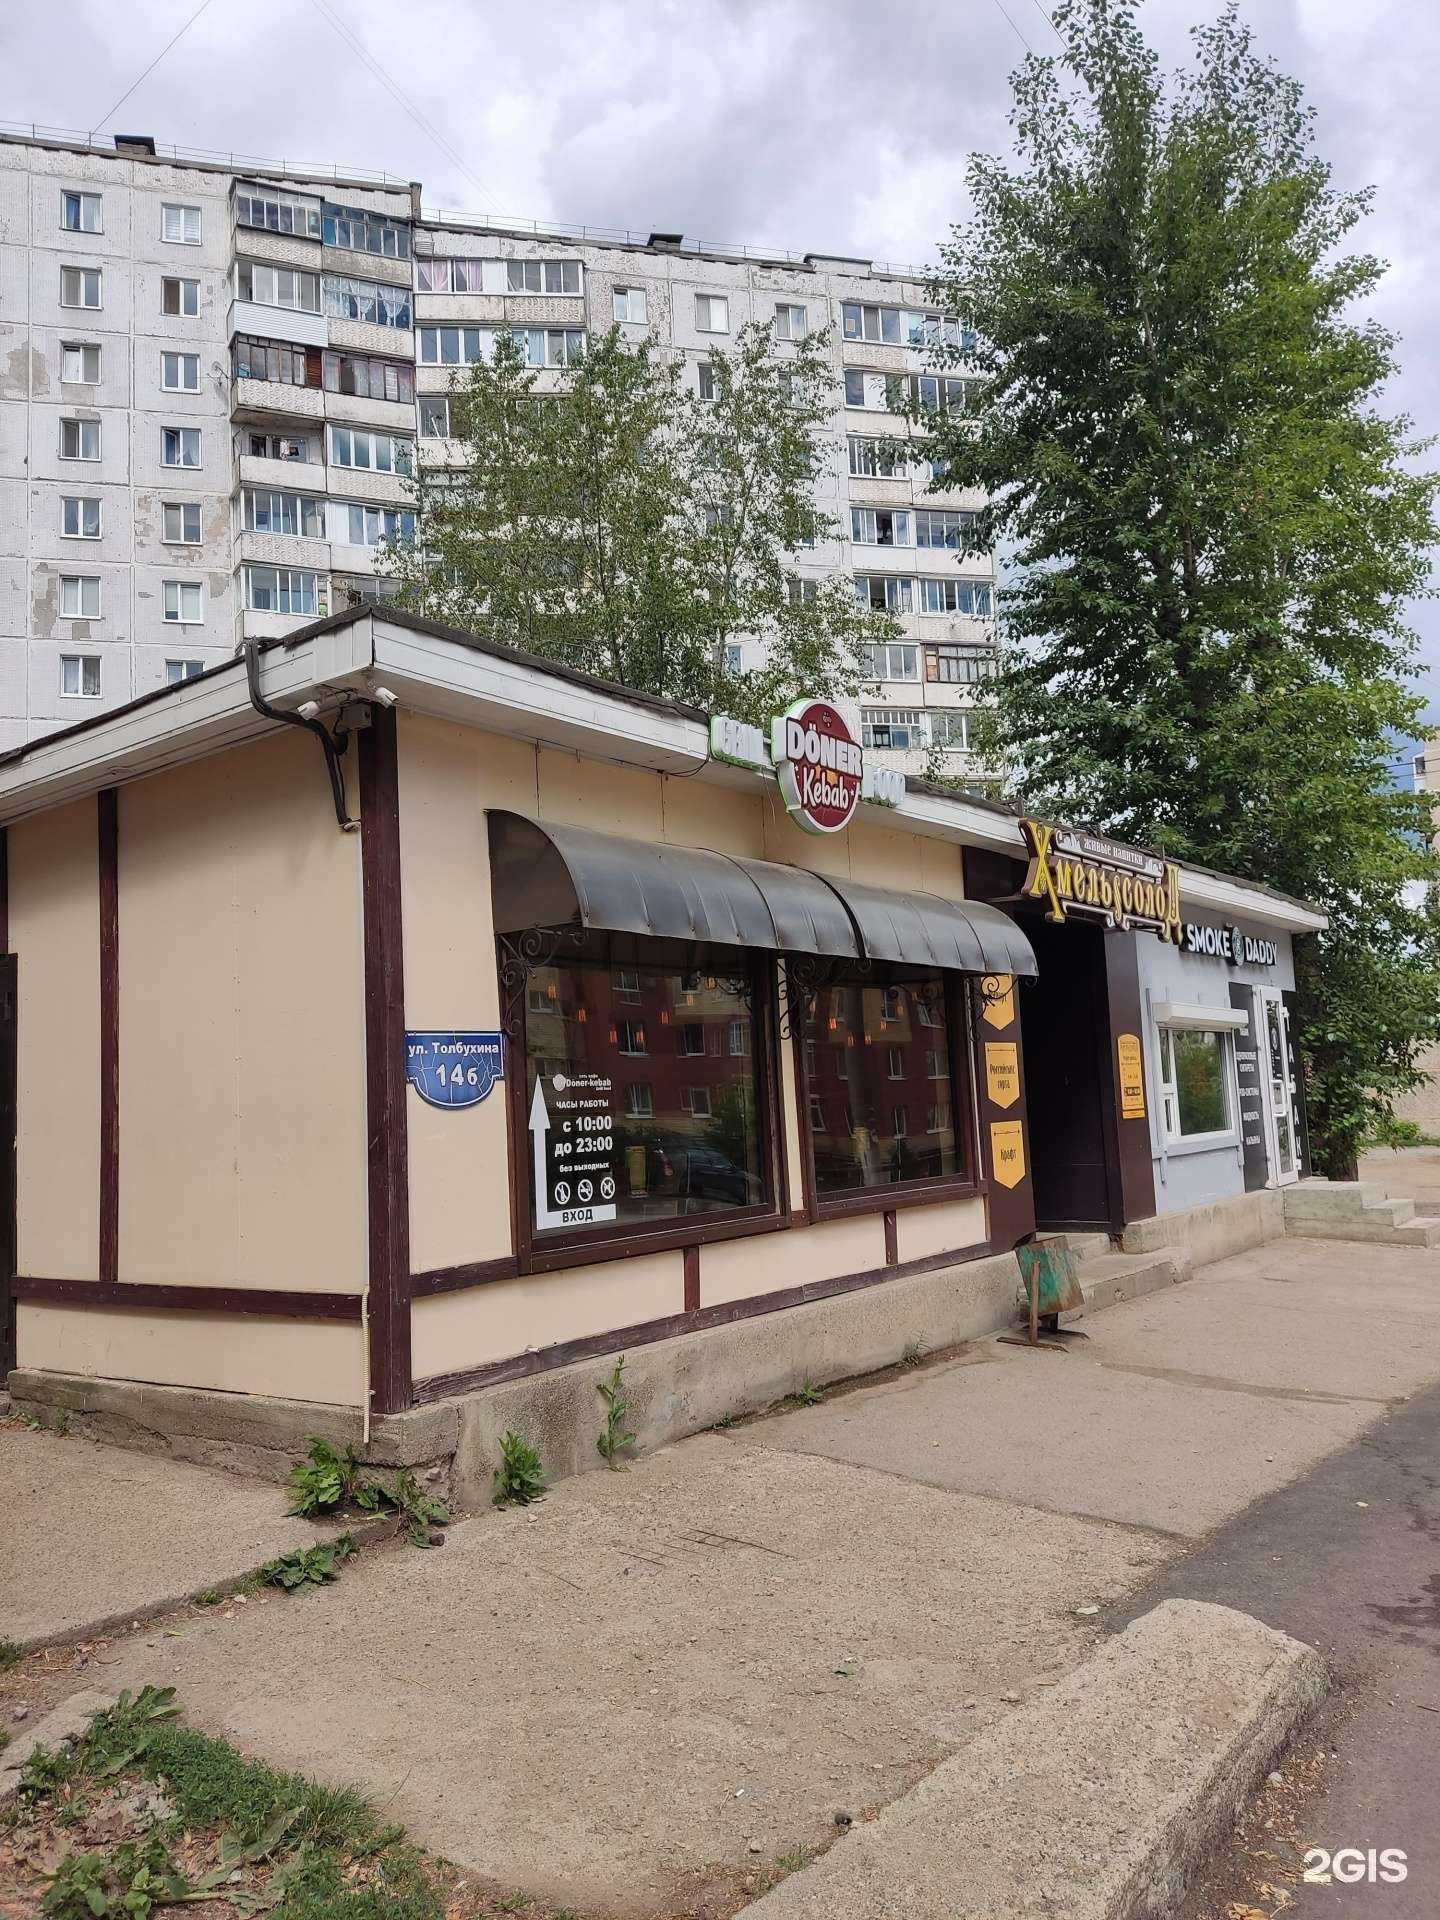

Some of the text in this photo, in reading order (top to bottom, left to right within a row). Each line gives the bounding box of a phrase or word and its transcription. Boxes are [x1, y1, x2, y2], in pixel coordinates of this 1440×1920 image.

[788, 721, 862, 777] DÖNER
[803, 766, 849, 810] Kebab
[1187, 923, 1231, 957] SMOKE
[1245, 937, 1277, 965] DADDY
[408, 1041, 499, 1058] ул. Толбухина
[556, 1099, 609, 1109] ЧАСЫ РАБОТЫ
[562, 1115, 612, 1133] с 10:00
[555, 1136, 613, 1157] до 23:00
[559, 1162, 610, 1173] без выходных
[562, 1208, 593, 1223] ВХОД
